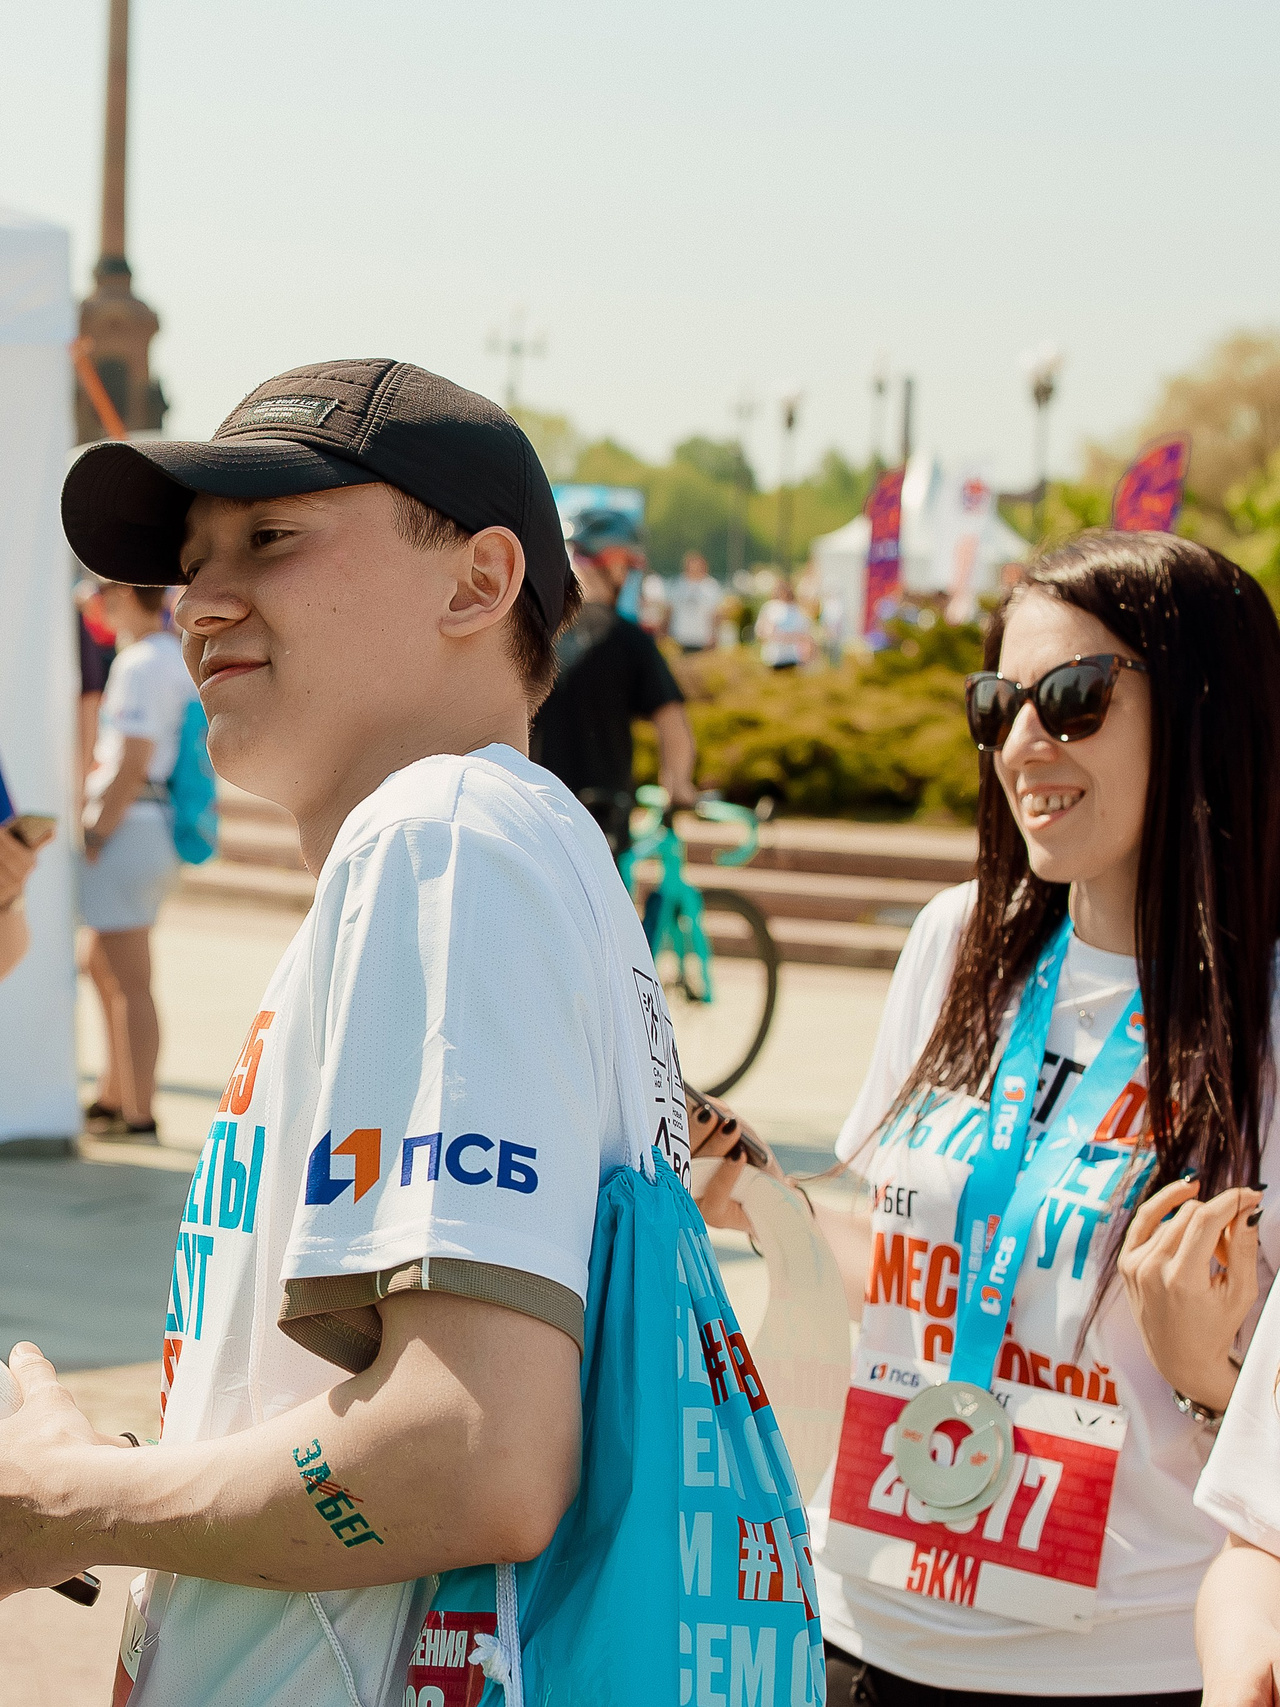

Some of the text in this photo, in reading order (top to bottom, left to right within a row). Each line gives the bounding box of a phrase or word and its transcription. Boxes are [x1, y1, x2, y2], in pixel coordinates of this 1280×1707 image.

[400, 1132, 539, 1195] ПСБ
[890, 1369, 921, 1388] ПСБ
[292, 1438, 385, 1548] ЗАБЕГ
